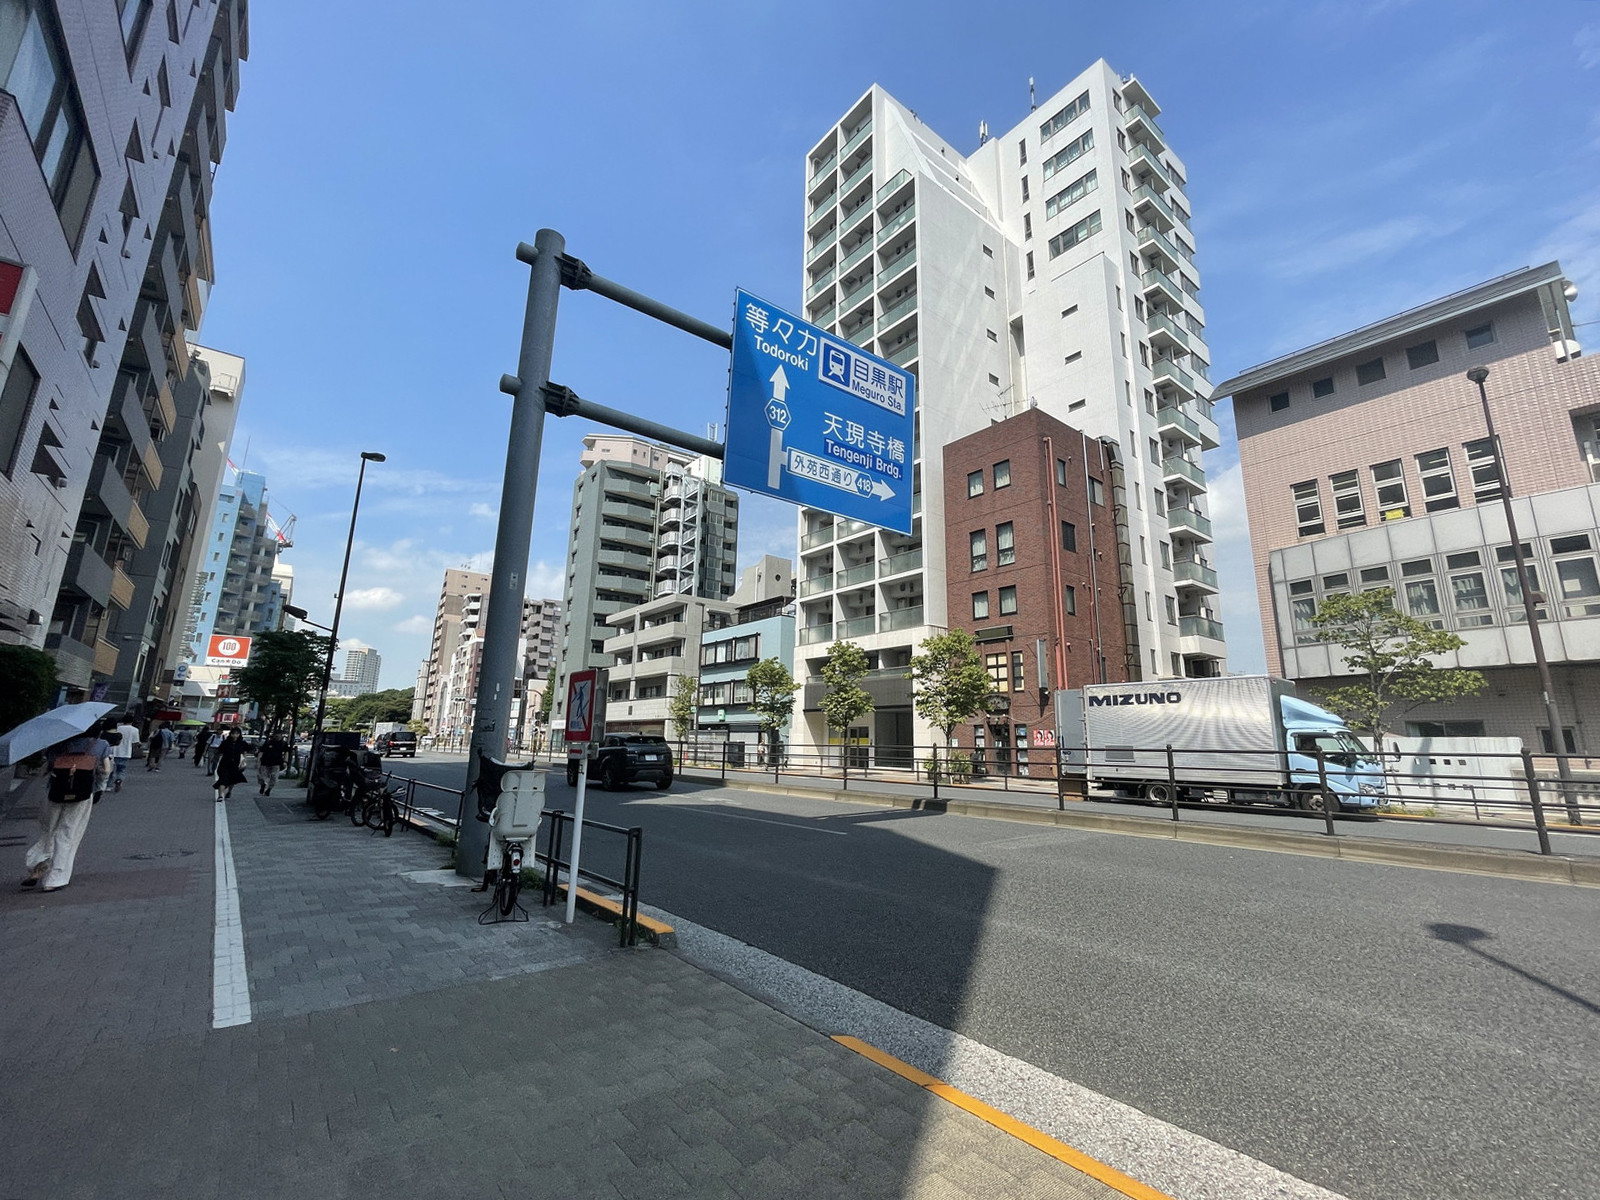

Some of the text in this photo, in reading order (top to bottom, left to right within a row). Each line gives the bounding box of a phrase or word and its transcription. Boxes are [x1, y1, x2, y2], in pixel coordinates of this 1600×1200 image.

[745, 303, 818, 356] 等々力
[754, 334, 809, 371] Todoroki
[854, 358, 904, 398] 目黒駅
[852, 379, 904, 411] Meguro Sta.
[769, 405, 787, 424] 312
[823, 411, 905, 464] 天現寺橋
[794, 455, 853, 487] 外苑西通り
[825, 438, 902, 479] Tengenji Brdg.
[856, 478, 871, 492] 418
[222, 641, 237, 651] 100
[1088, 691, 1182, 707] MIZUNO
